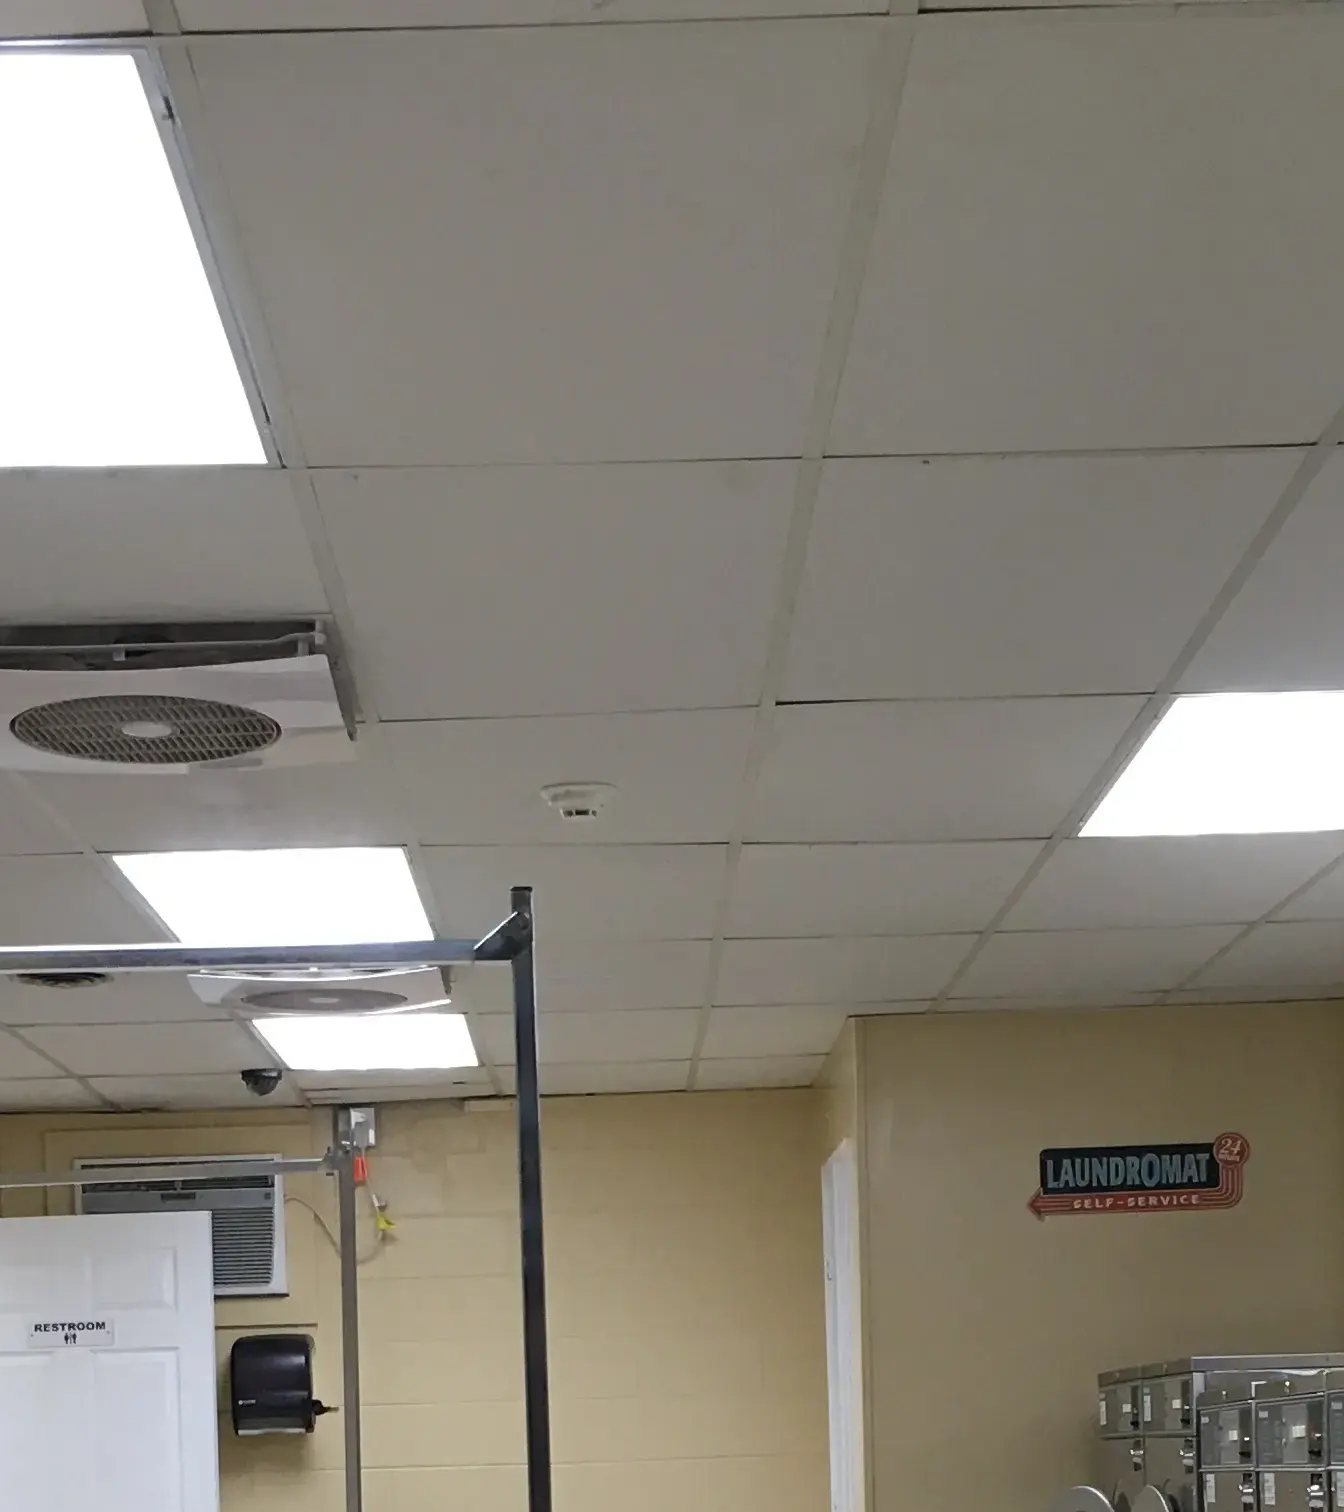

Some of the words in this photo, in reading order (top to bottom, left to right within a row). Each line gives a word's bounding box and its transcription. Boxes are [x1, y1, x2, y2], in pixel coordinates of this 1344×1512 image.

[1220, 1138, 1242, 1155] 24
[1046, 1152, 1210, 1189] LAUNDROMAT
[1072, 1193, 1201, 1210] SELF-SERVICE
[33, 1321, 106, 1333] RESTROOM
